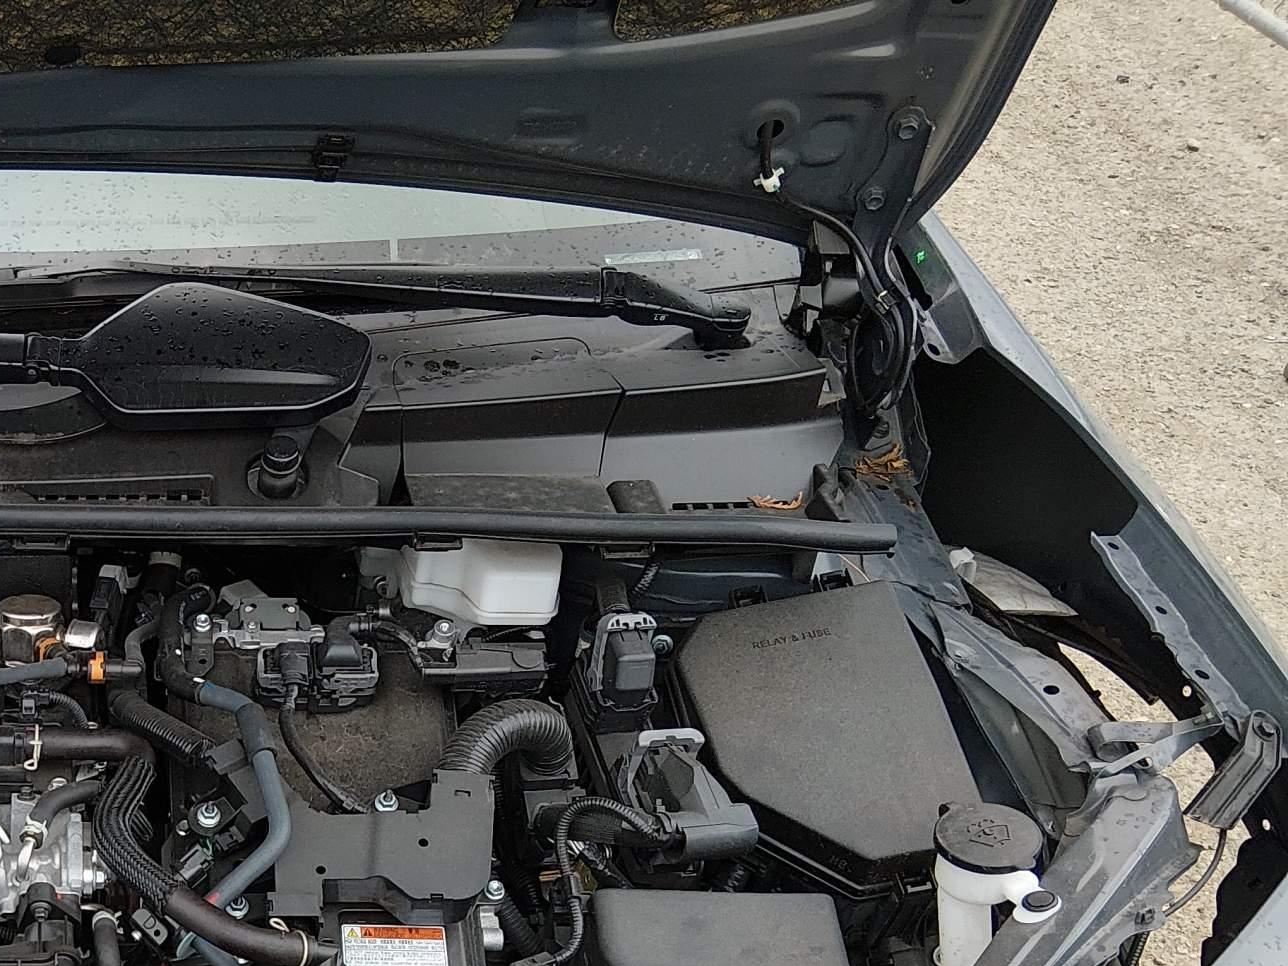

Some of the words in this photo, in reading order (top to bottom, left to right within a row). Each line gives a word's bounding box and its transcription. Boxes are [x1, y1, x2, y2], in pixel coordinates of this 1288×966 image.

[752, 636, 787, 649] RELAY
[791, 634, 799, 642] &
[801, 628, 831, 641] FUSE
